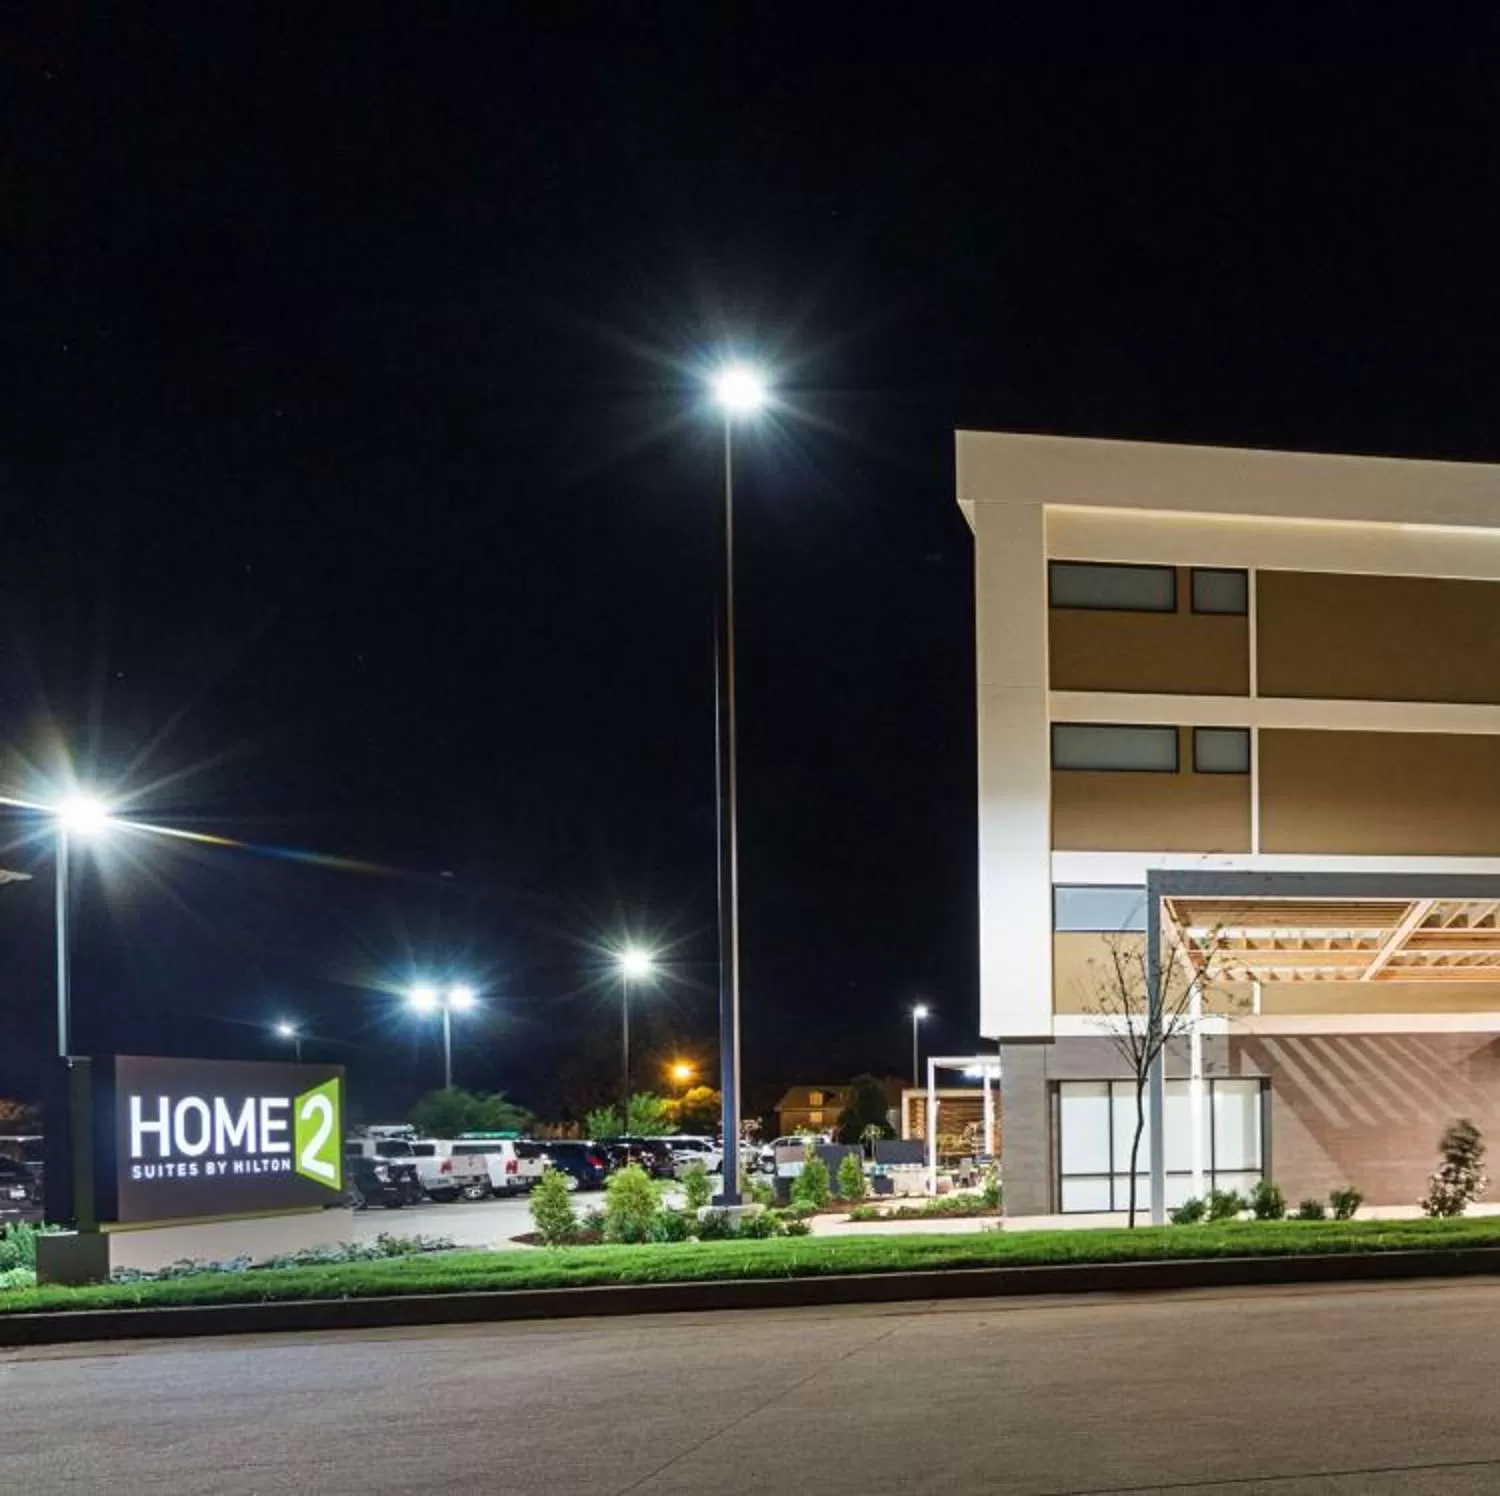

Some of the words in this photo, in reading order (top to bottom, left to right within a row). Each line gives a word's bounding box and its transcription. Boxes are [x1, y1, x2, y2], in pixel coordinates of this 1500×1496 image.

[131, 1162, 200, 1180] SUITES
[204, 1160, 229, 1176] BY
[232, 1157, 292, 1174] HILTON
